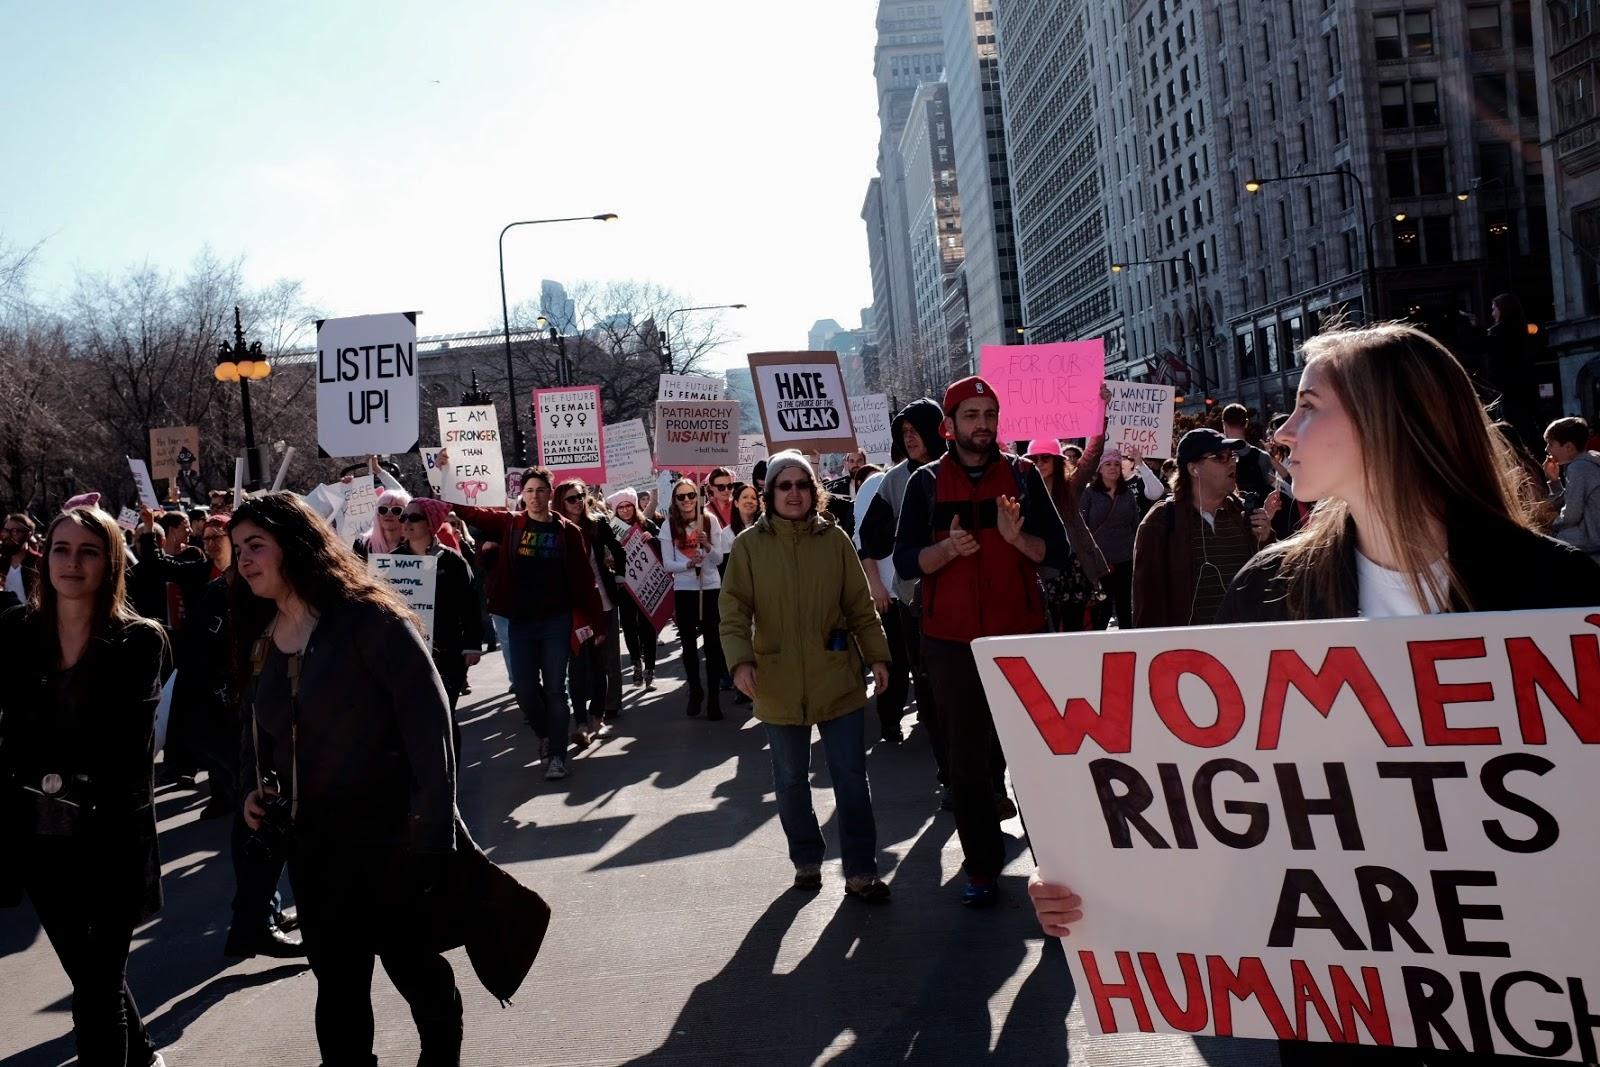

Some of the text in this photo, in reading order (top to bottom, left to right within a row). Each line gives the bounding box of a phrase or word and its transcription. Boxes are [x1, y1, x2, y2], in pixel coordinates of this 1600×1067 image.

[318, 342, 414, 384] LISTEN
[1008, 353, 1082, 375] FOR OUR
[686, 382, 719, 392] FUTURE
[774, 372, 827, 400] HATE
[1007, 374, 1082, 408] FUTURE
[561, 392, 594, 402] FUTURE
[679, 392, 718, 400] FEMALE
[1120, 388, 1168, 402] WANTED
[348, 390, 389, 425] UP!
[541, 402, 595, 413] IS FEMALE
[1108, 400, 1162, 414] VERNMENT
[447, 410, 488, 423] I AM
[781, 408, 836, 430] WEAK
[1034, 410, 1080, 432] MARCH
[1120, 415, 1160, 428] UTERUS
[666, 420, 729, 430] PROMOTES
[446, 430, 498, 442] STRONGER
[1124, 428, 1157, 443] FUCK
[462, 448, 483, 456] THAN
[544, 445, 598, 454] DAMENTAL
[546, 453, 598, 464] HUMAN RIGHTS
[456, 465, 491, 477] FEAR
[377, 559, 423, 569] I WANT
[1088, 752, 1561, 854] RIGHTS
[1266, 865, 1512, 958] ARE
[1077, 950, 1394, 1046] HUMAN
